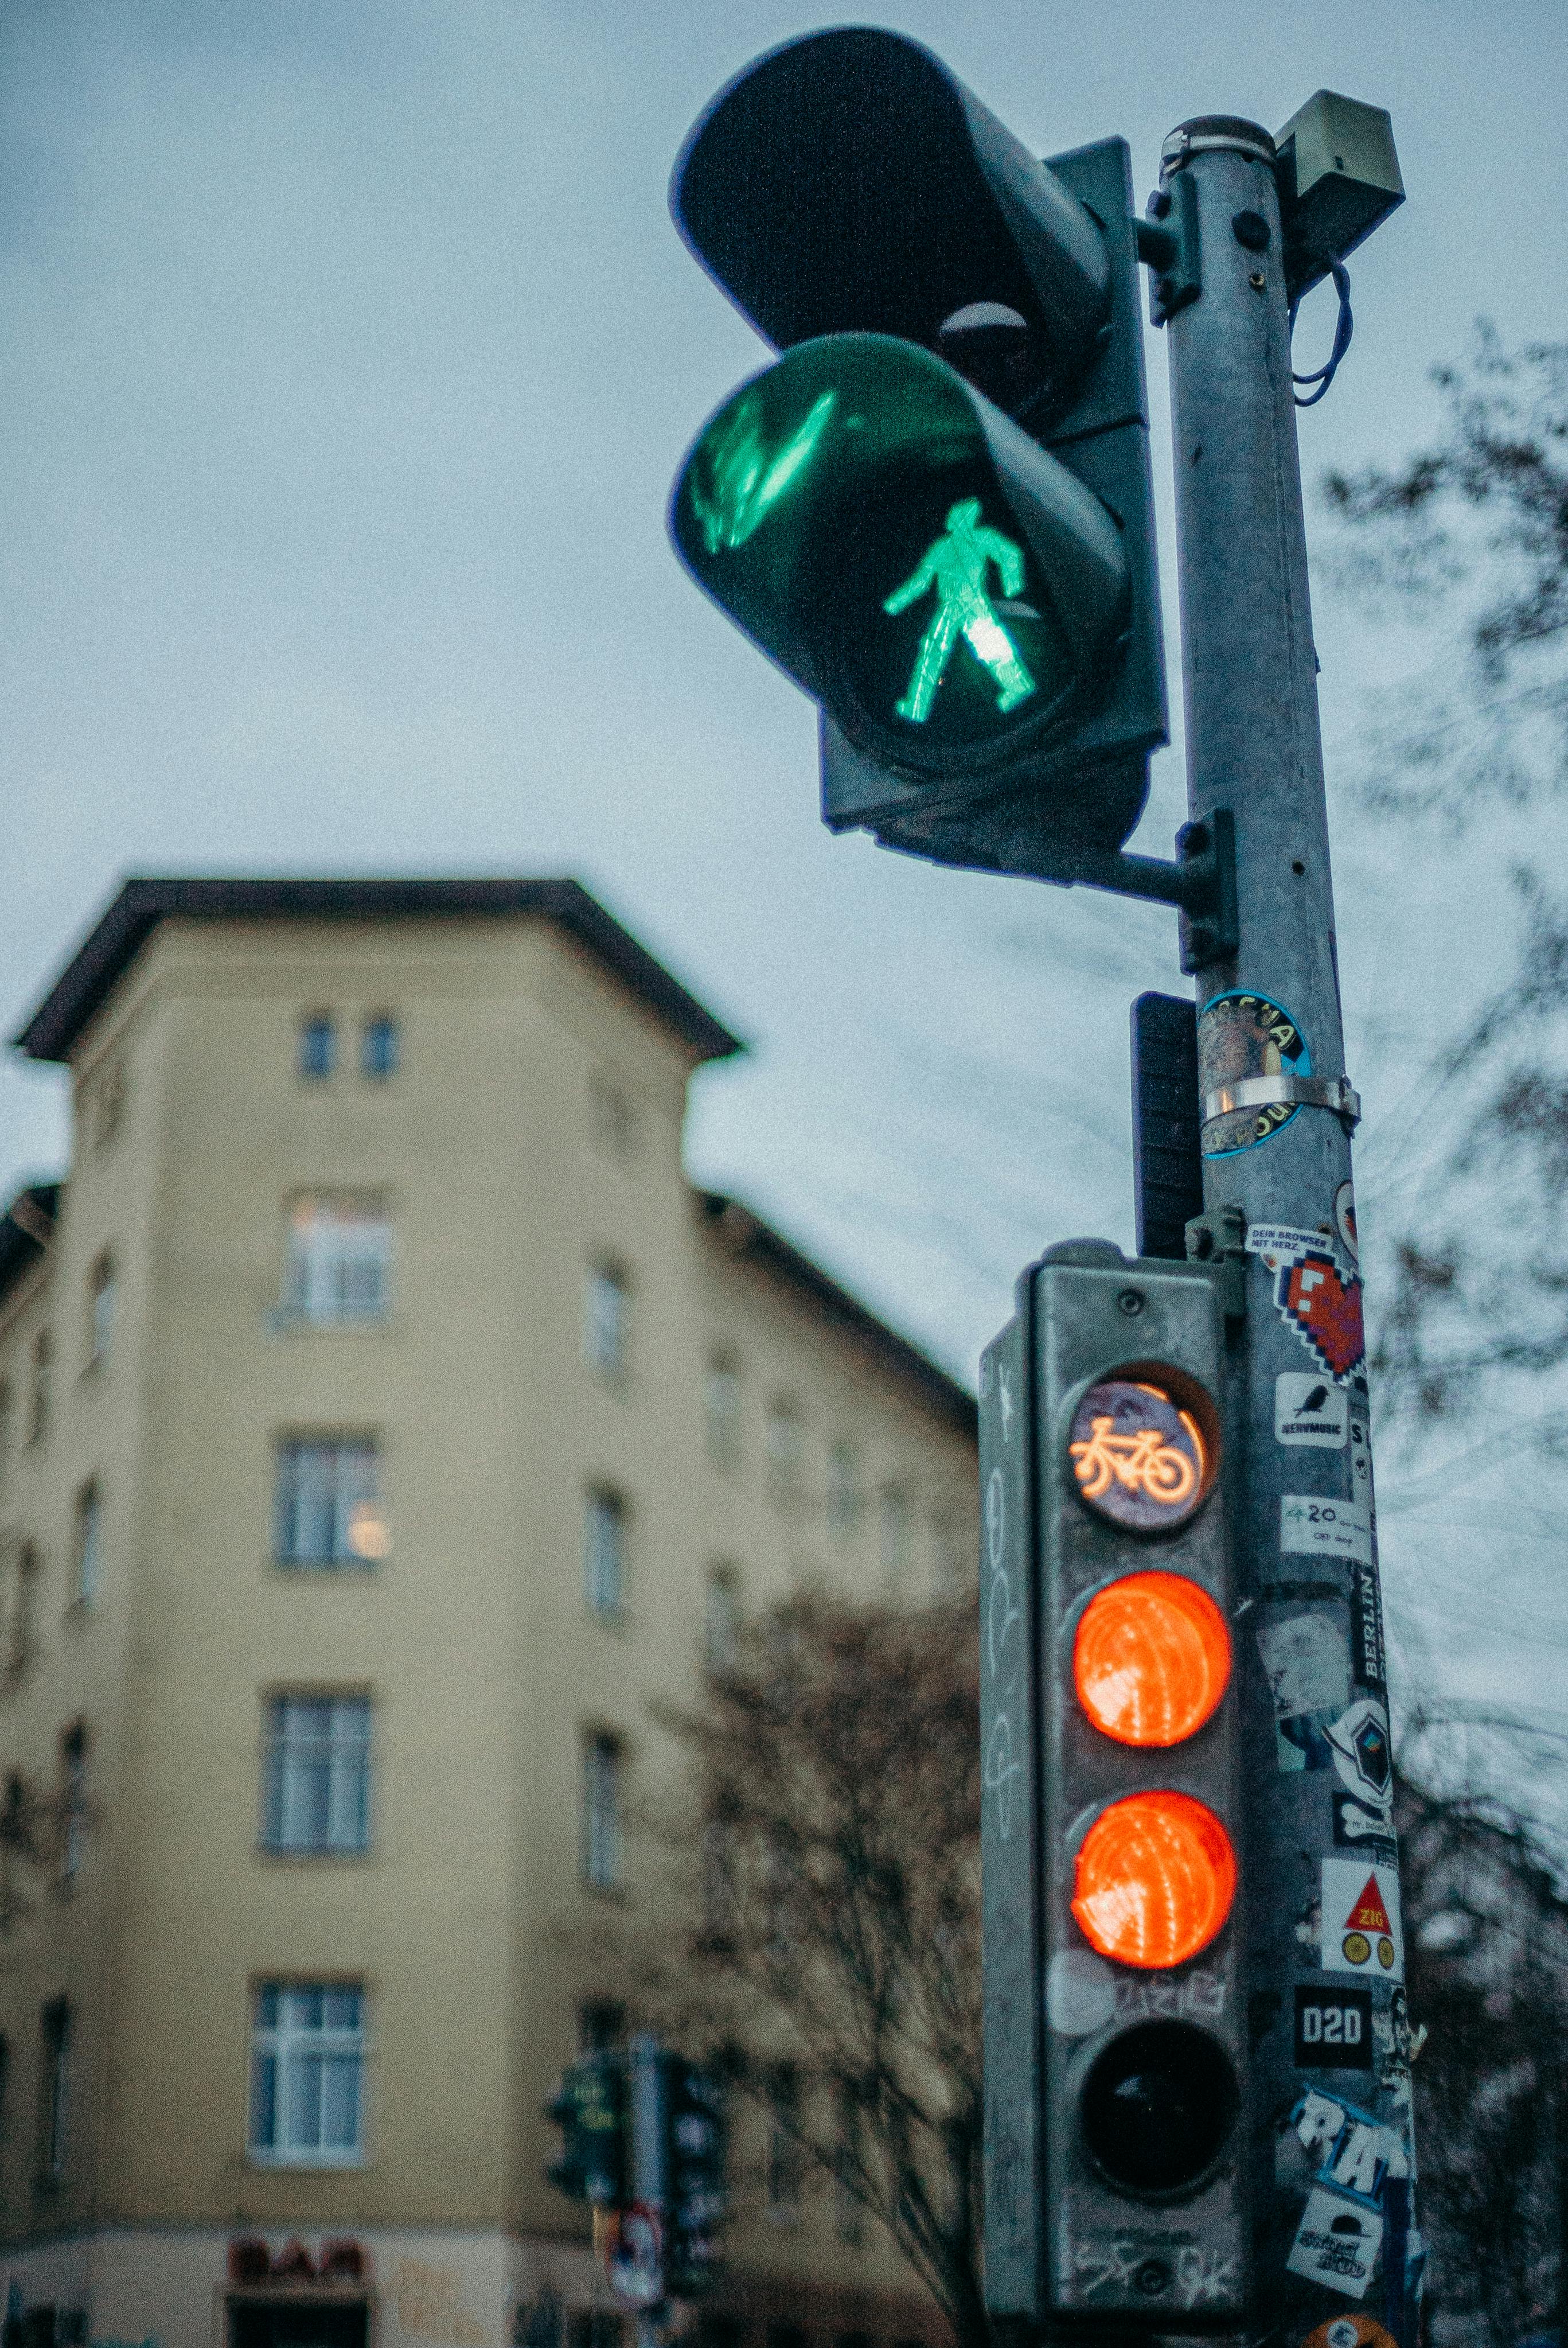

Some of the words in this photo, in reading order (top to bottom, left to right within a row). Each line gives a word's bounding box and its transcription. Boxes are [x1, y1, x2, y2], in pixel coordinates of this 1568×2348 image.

[1252, 1230, 1275, 1238] DEIN
[1278, 1231, 1327, 1248] BROWSER
[1359, 1573, 1378, 1679] BERLIN
[1359, 1908, 1384, 1928] ZIG
